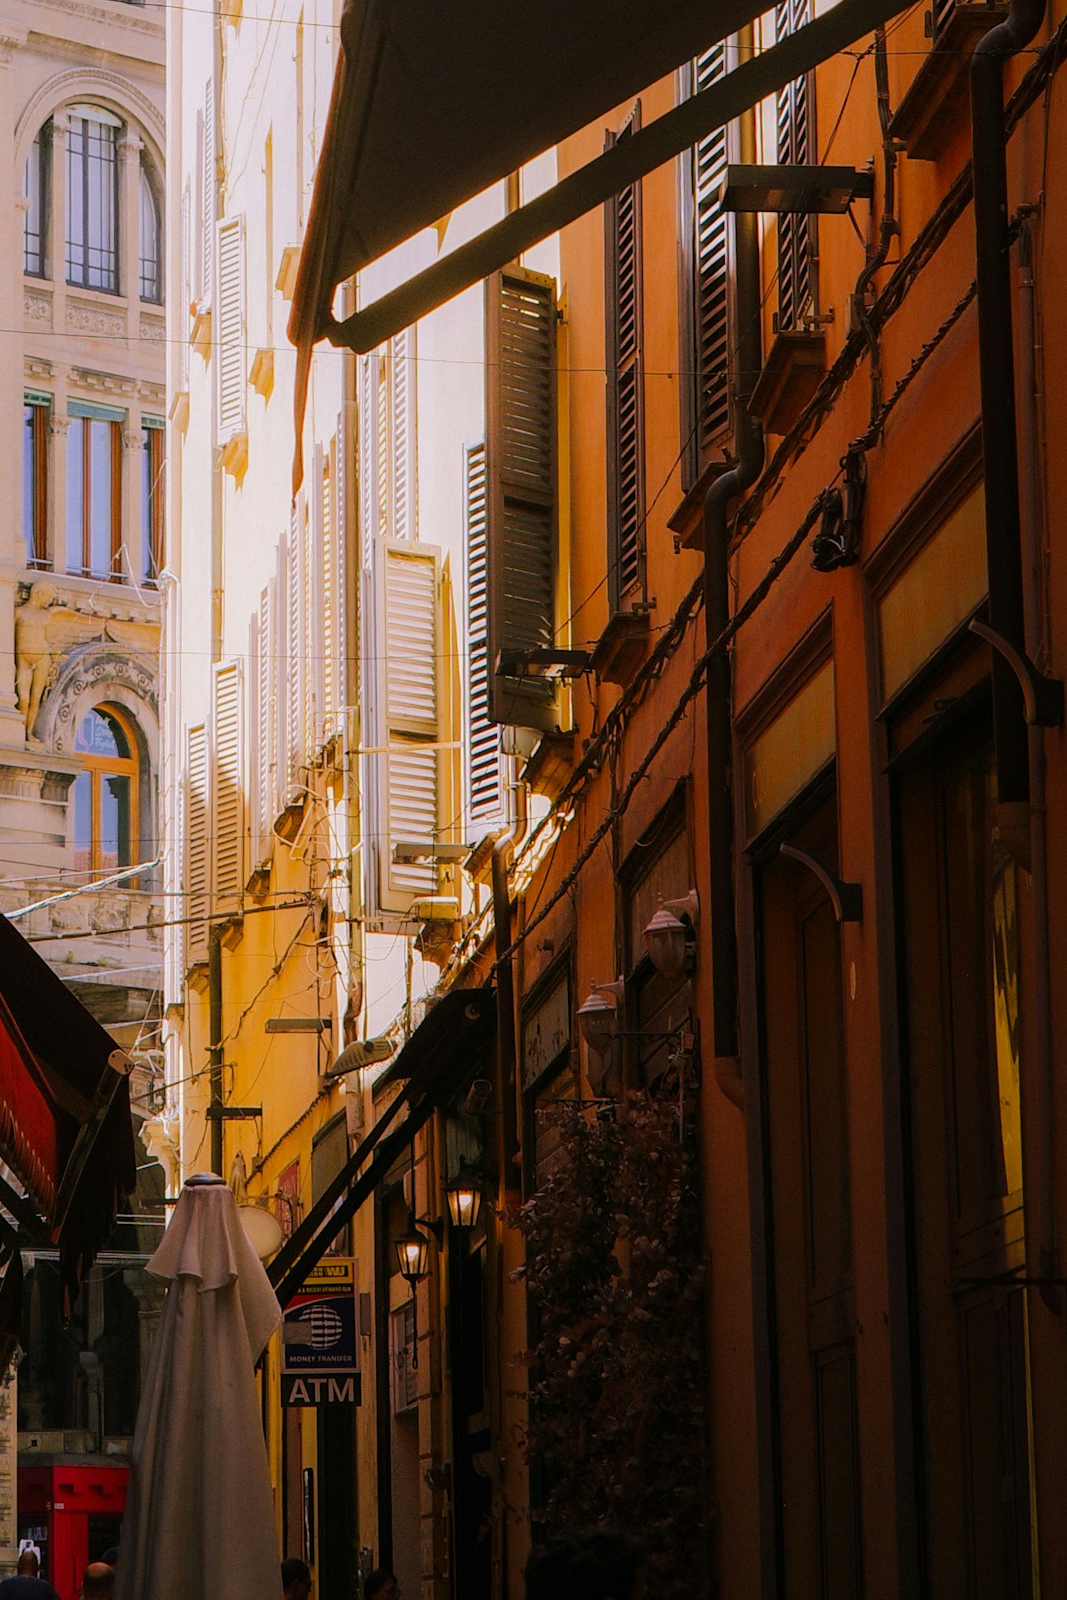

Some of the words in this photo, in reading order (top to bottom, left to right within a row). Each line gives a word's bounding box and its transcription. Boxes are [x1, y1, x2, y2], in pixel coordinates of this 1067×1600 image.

[288, 1355, 315, 1363] MONEY
[317, 1354, 353, 1362] TRANSFER
[288, 1377, 355, 1403] ATM
